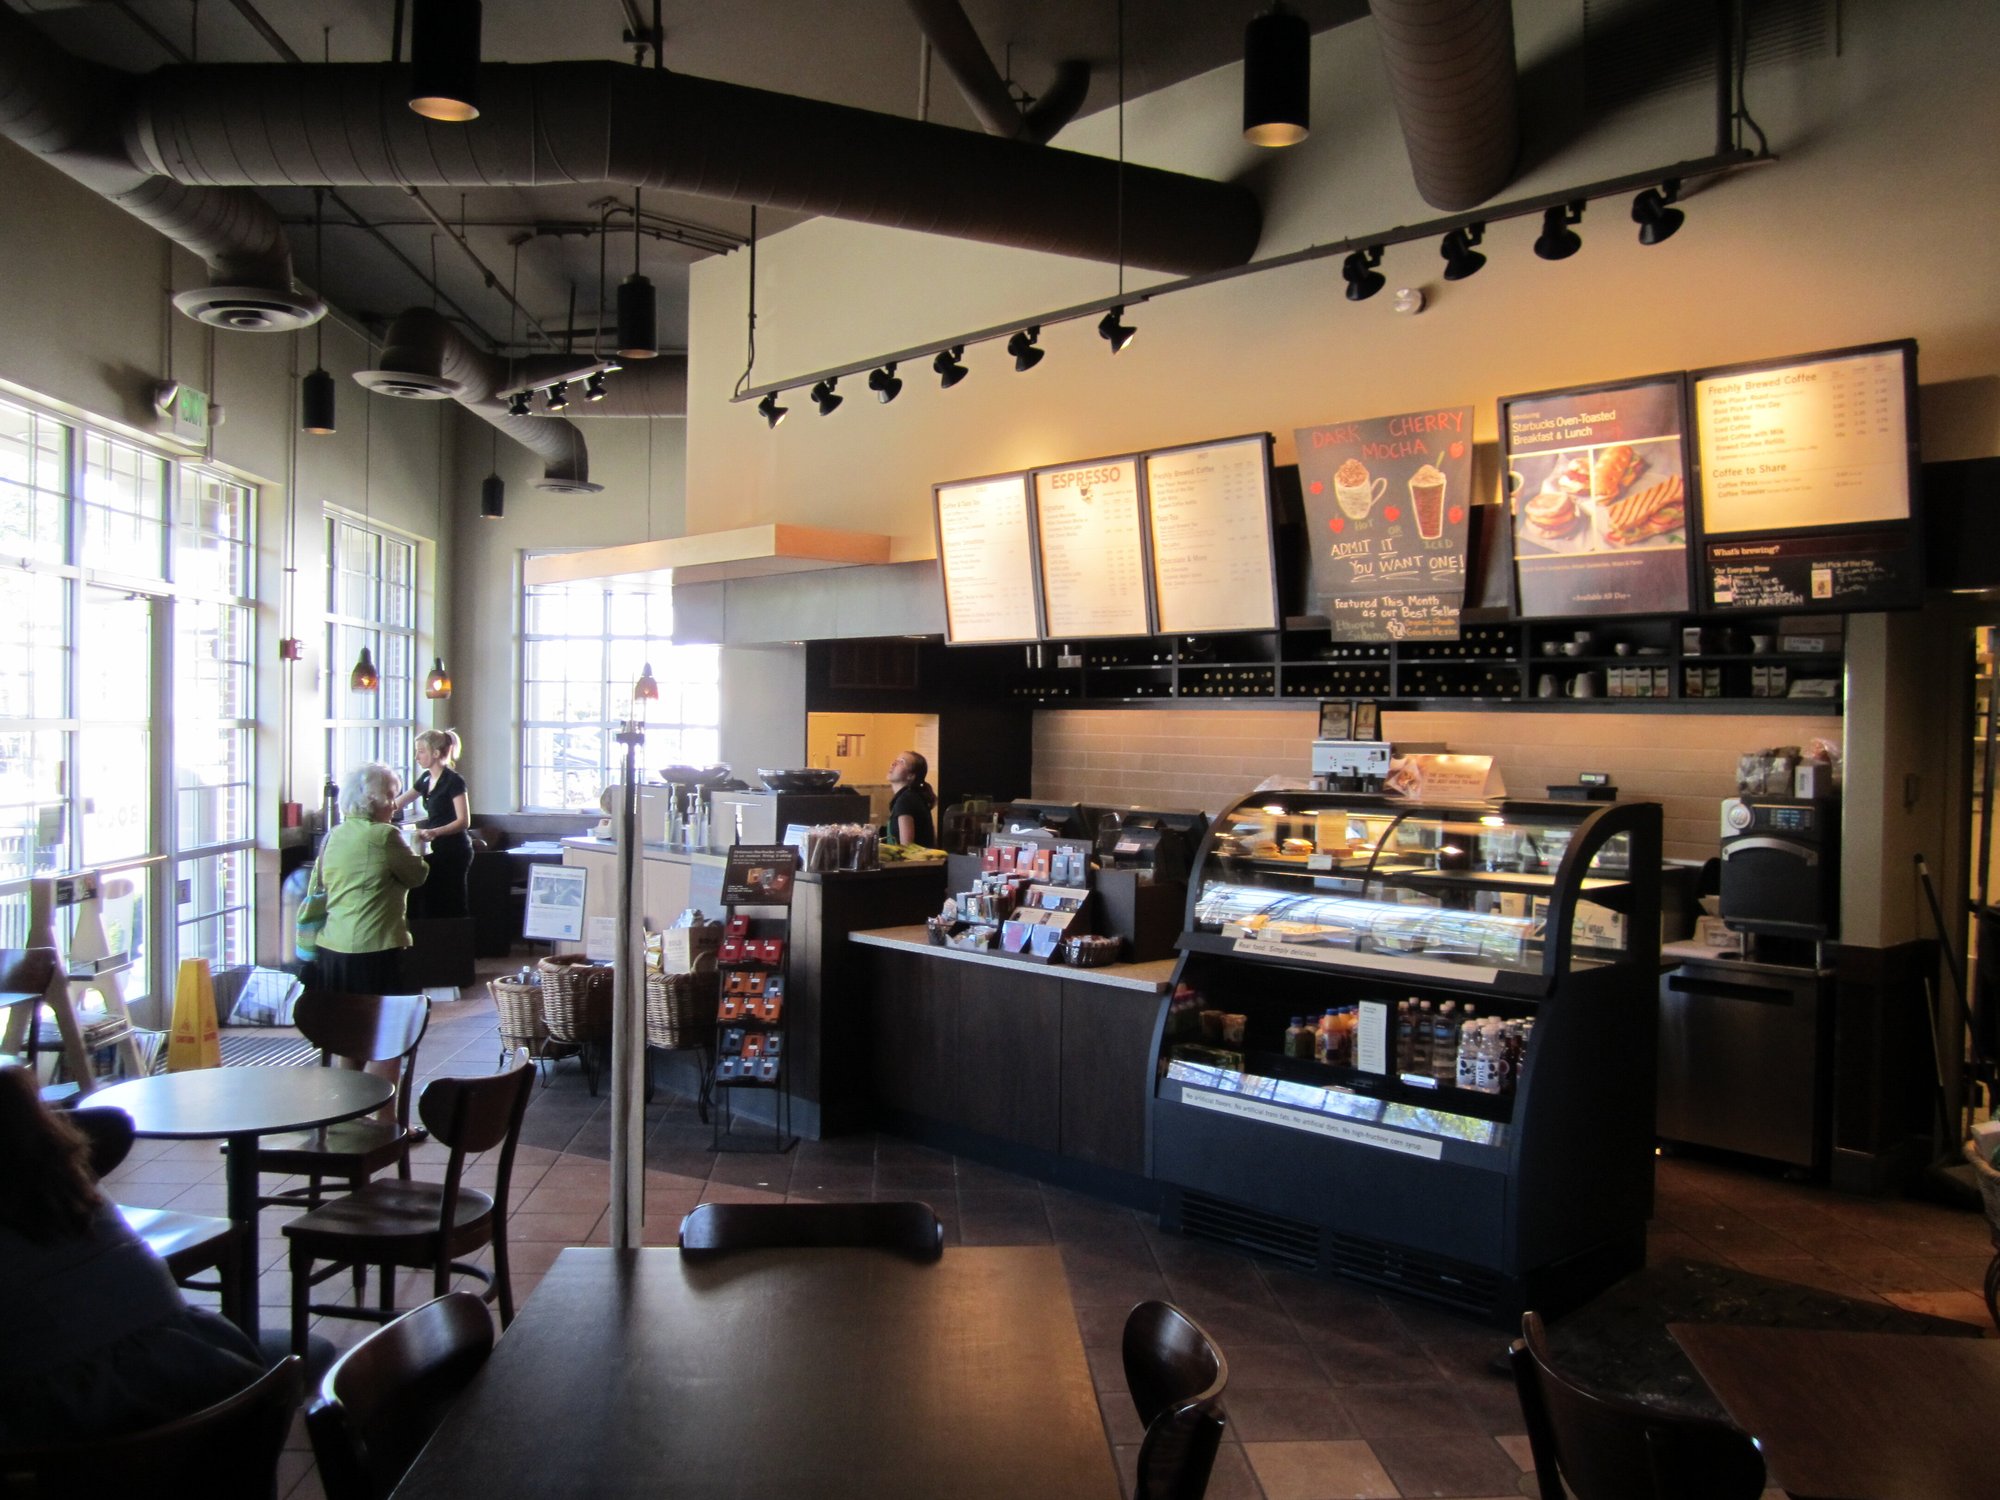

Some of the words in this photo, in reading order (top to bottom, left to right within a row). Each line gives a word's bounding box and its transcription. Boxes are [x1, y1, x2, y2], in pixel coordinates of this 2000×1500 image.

[1708, 383, 1741, 396] Freshly
[1744, 378, 1780, 391] Brewed
[1784, 373, 1817, 384] Coffee
[1388, 412, 1464, 438] CHERRY
[1512, 419, 1555, 433] Starbucks
[1556, 410, 1616, 426] Oven-Toasted
[1312, 424, 1361, 449] DARK
[1512, 432, 1554, 445] Breakfast
[1564, 426, 1593, 439] Lunch
[1362, 438, 1428, 460] MOCHA
[1052, 466, 1121, 490] ESPRESSO
[1712, 468, 1743, 478] Coffee
[1746, 467, 1756, 475] to
[1759, 463, 1786, 474] Share
[1330, 538, 1371, 556] ADMIT
[1381, 538, 1393, 552] IT
[1741, 545, 1780, 555] brewing?
[1349, 560, 1373, 575] YOU
[1379, 555, 1424, 573] WANT
[1428, 554, 1465, 574] ONE!
[1334, 598, 1378, 609] Featured
[1381, 596, 1404, 607] This
[1408, 595, 1440, 606] Month
[1757, 595, 1804, 607] AMERICAN
[1362, 609, 1376, 618] as
[1380, 609, 1398, 618] our
[1402, 606, 1428, 618] Best
[1243, 1105, 1263, 1115] artificial
